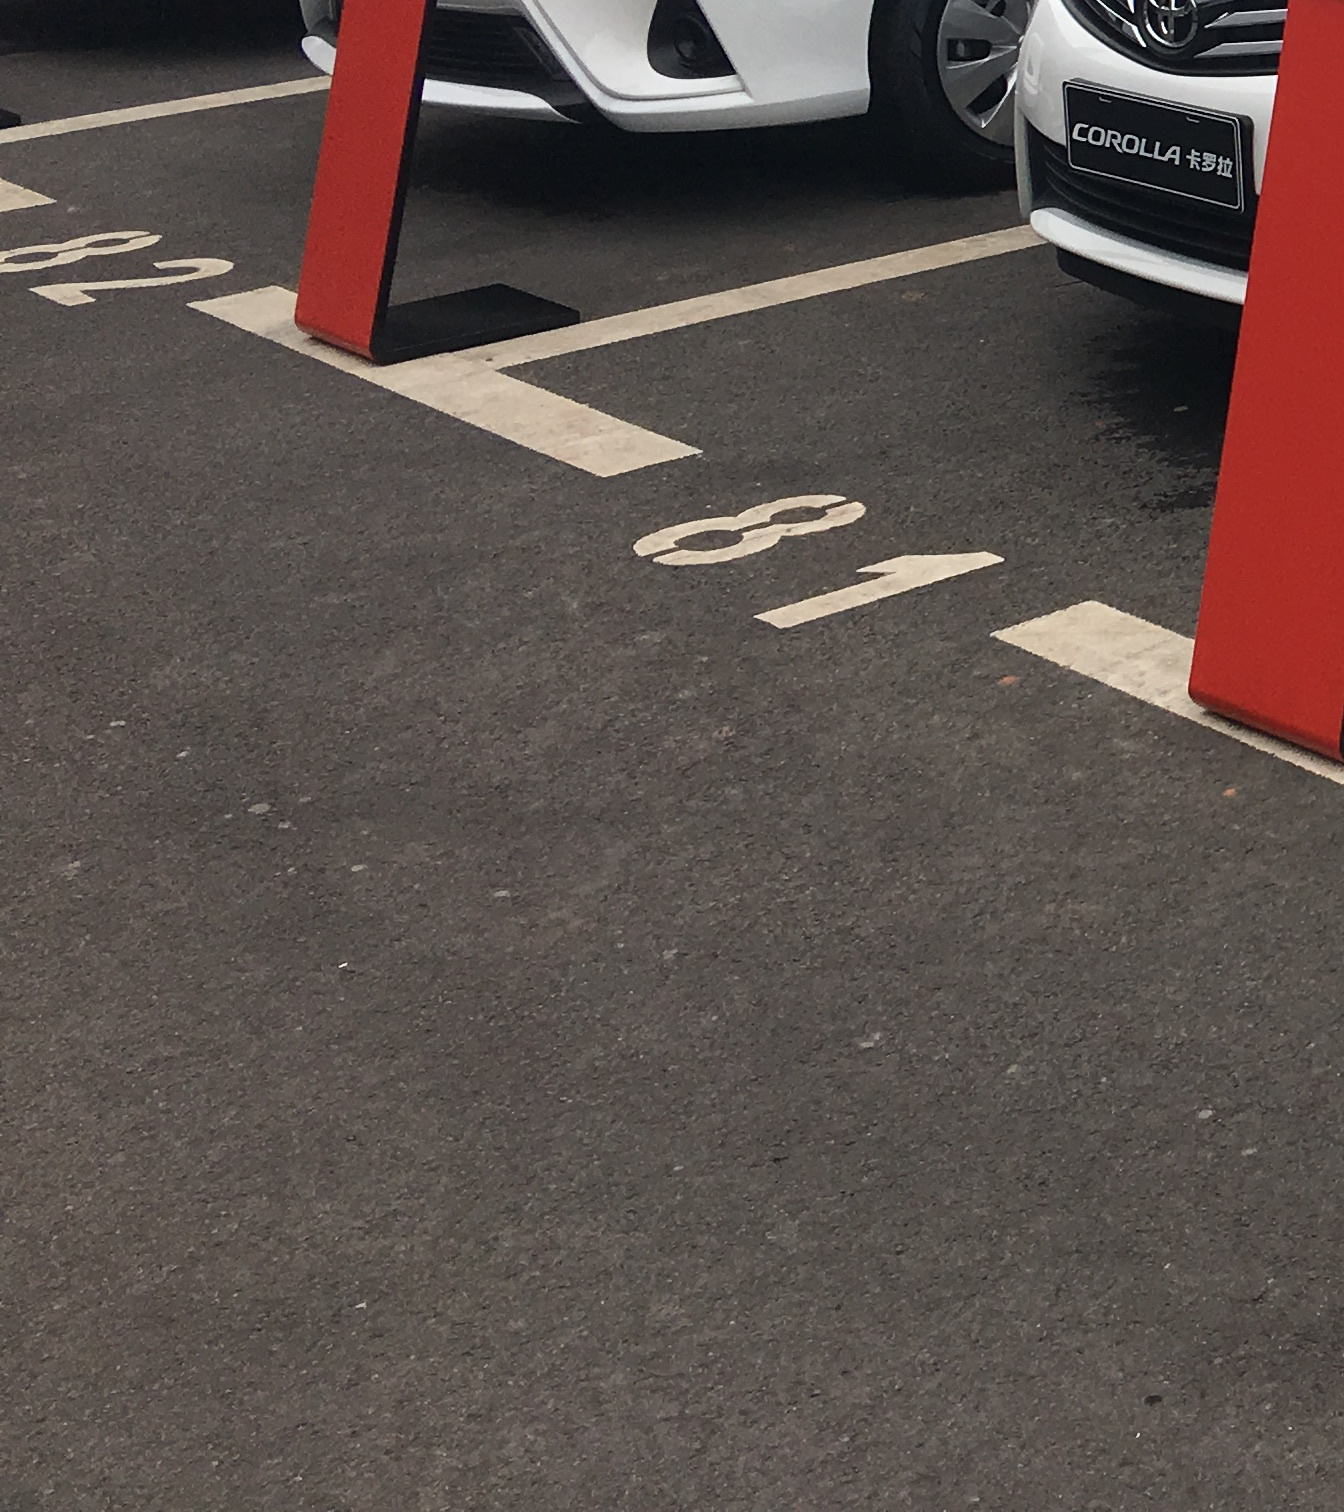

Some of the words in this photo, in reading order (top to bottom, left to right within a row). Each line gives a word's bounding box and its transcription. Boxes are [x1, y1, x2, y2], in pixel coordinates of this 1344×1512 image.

[1072, 123, 1181, 166] COROLLA
[1186, 148, 1234, 179] 卡罗拉
[0, 230, 235, 307] 82
[633, 494, 1005, 630] 81
